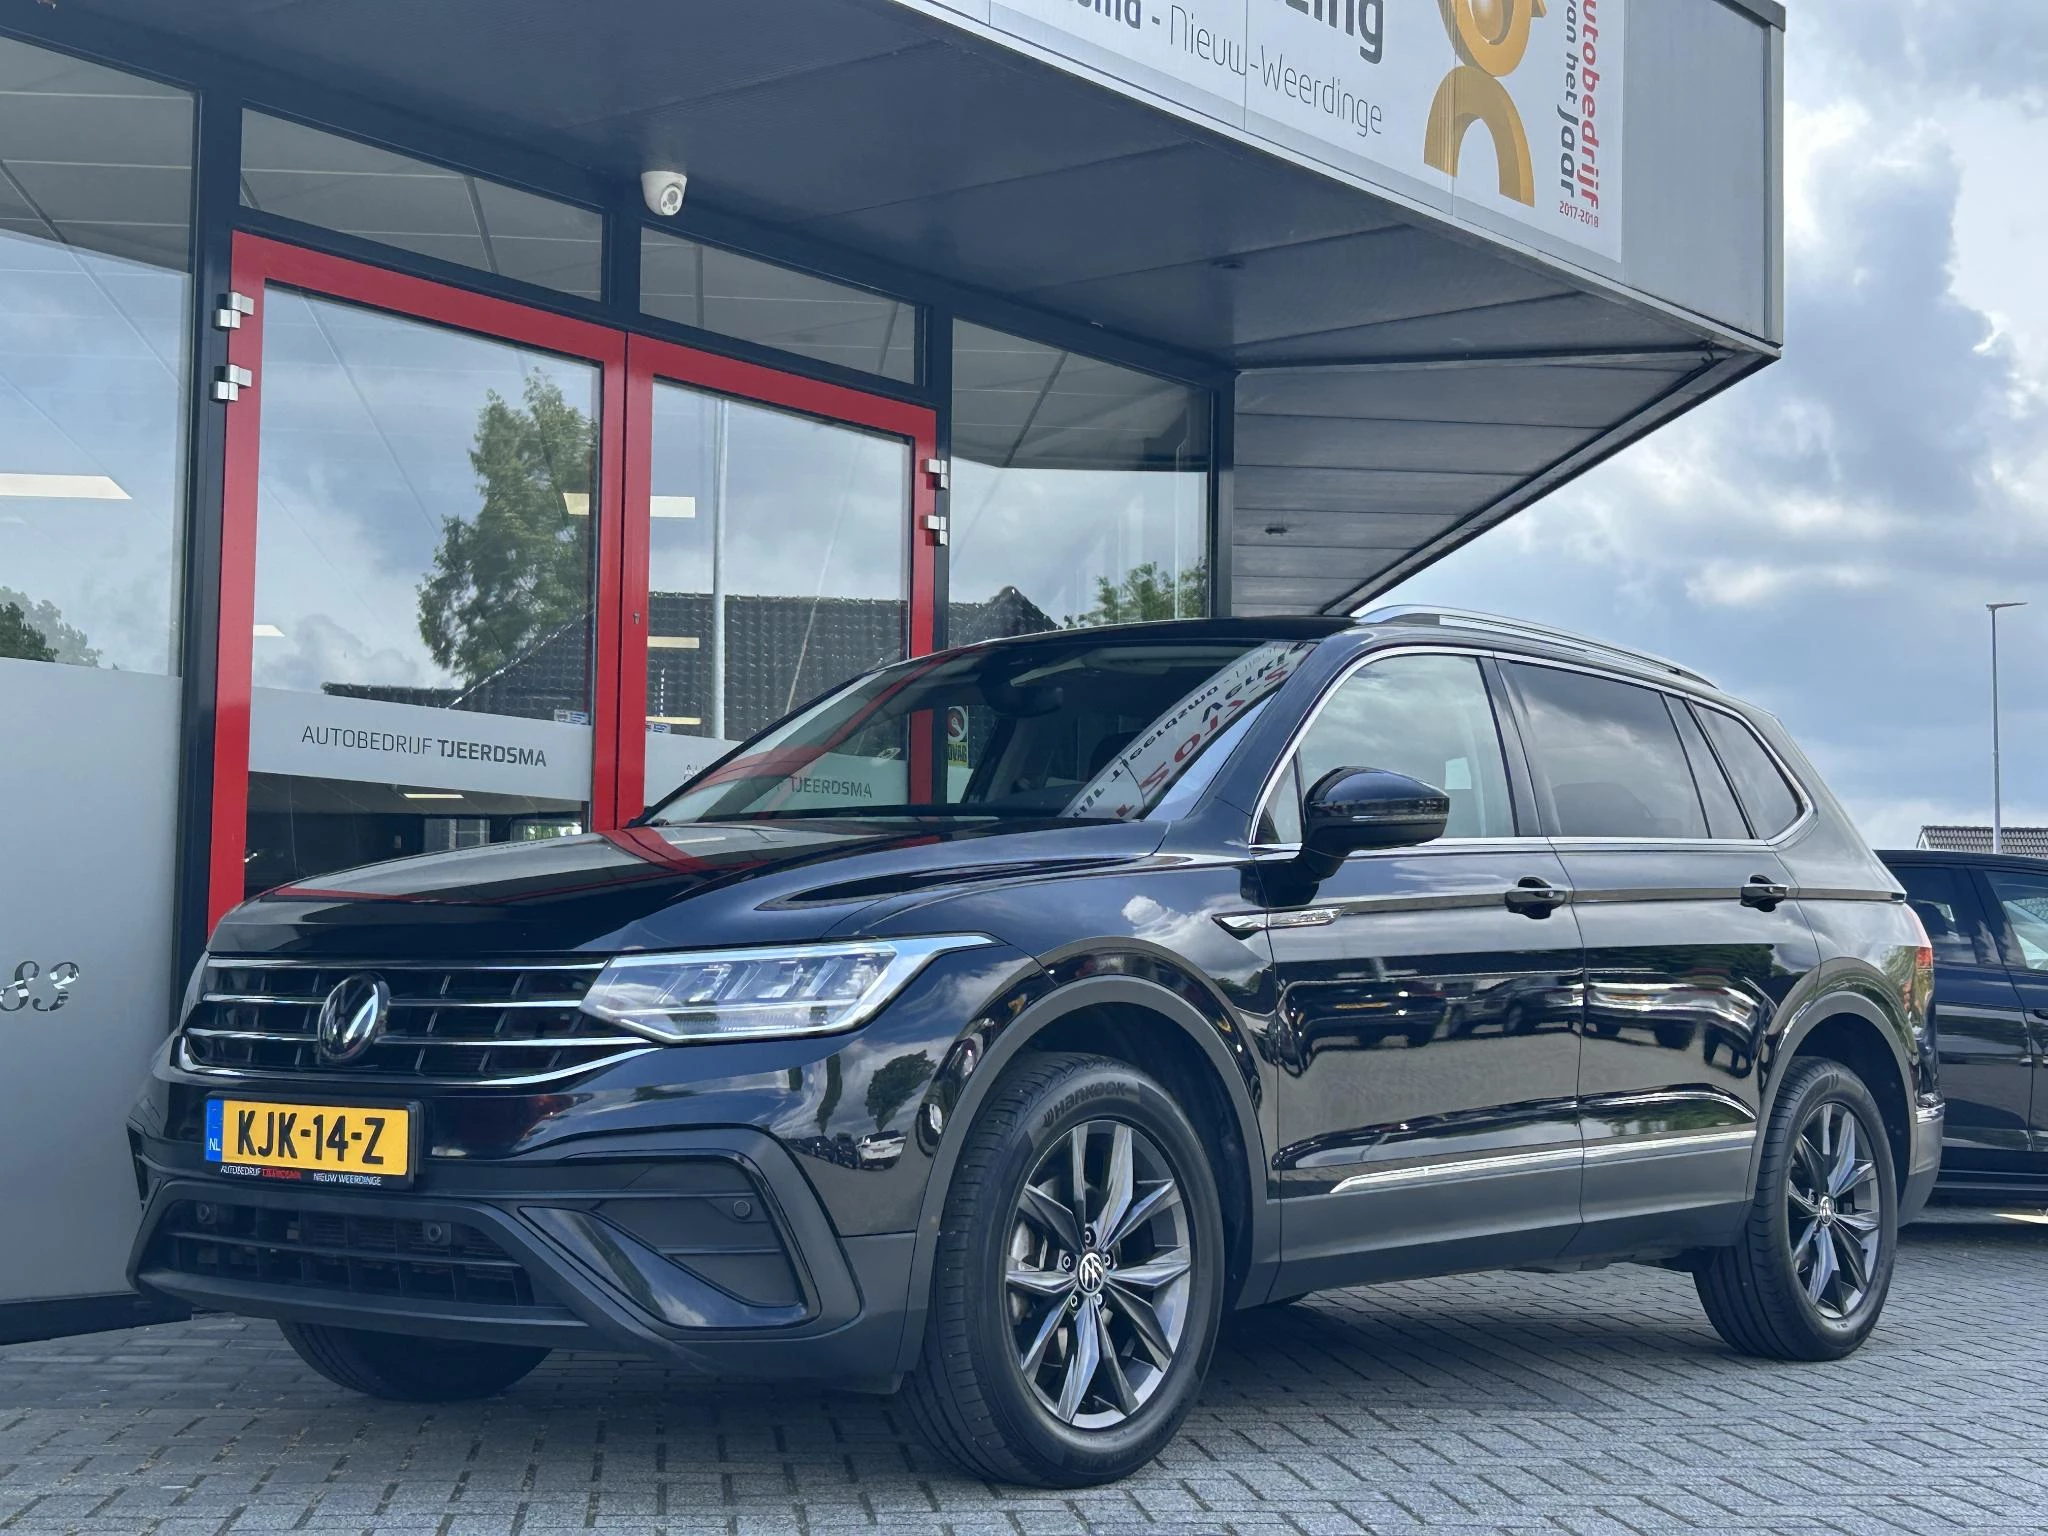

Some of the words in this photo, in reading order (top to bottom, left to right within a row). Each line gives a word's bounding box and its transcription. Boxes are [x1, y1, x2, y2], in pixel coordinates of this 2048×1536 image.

[1170, 4, 1383, 138] Nieuw-Weerdinge
[1566, 52, 1579, 105] het
[1576, 0, 1600, 210] utobedrijf
[1559, 200, 1599, 228] 2017-2018
[301, 725, 433, 755] AUTOBEDRIJF
[437, 739, 547, 767] TJEERDSMA
[790, 776, 873, 799] TJEERDSMA
[0, 960, 80, 1012] 83
[209, 1138, 221, 1152] NL
[237, 1109, 386, 1165] KJK-14-Z
